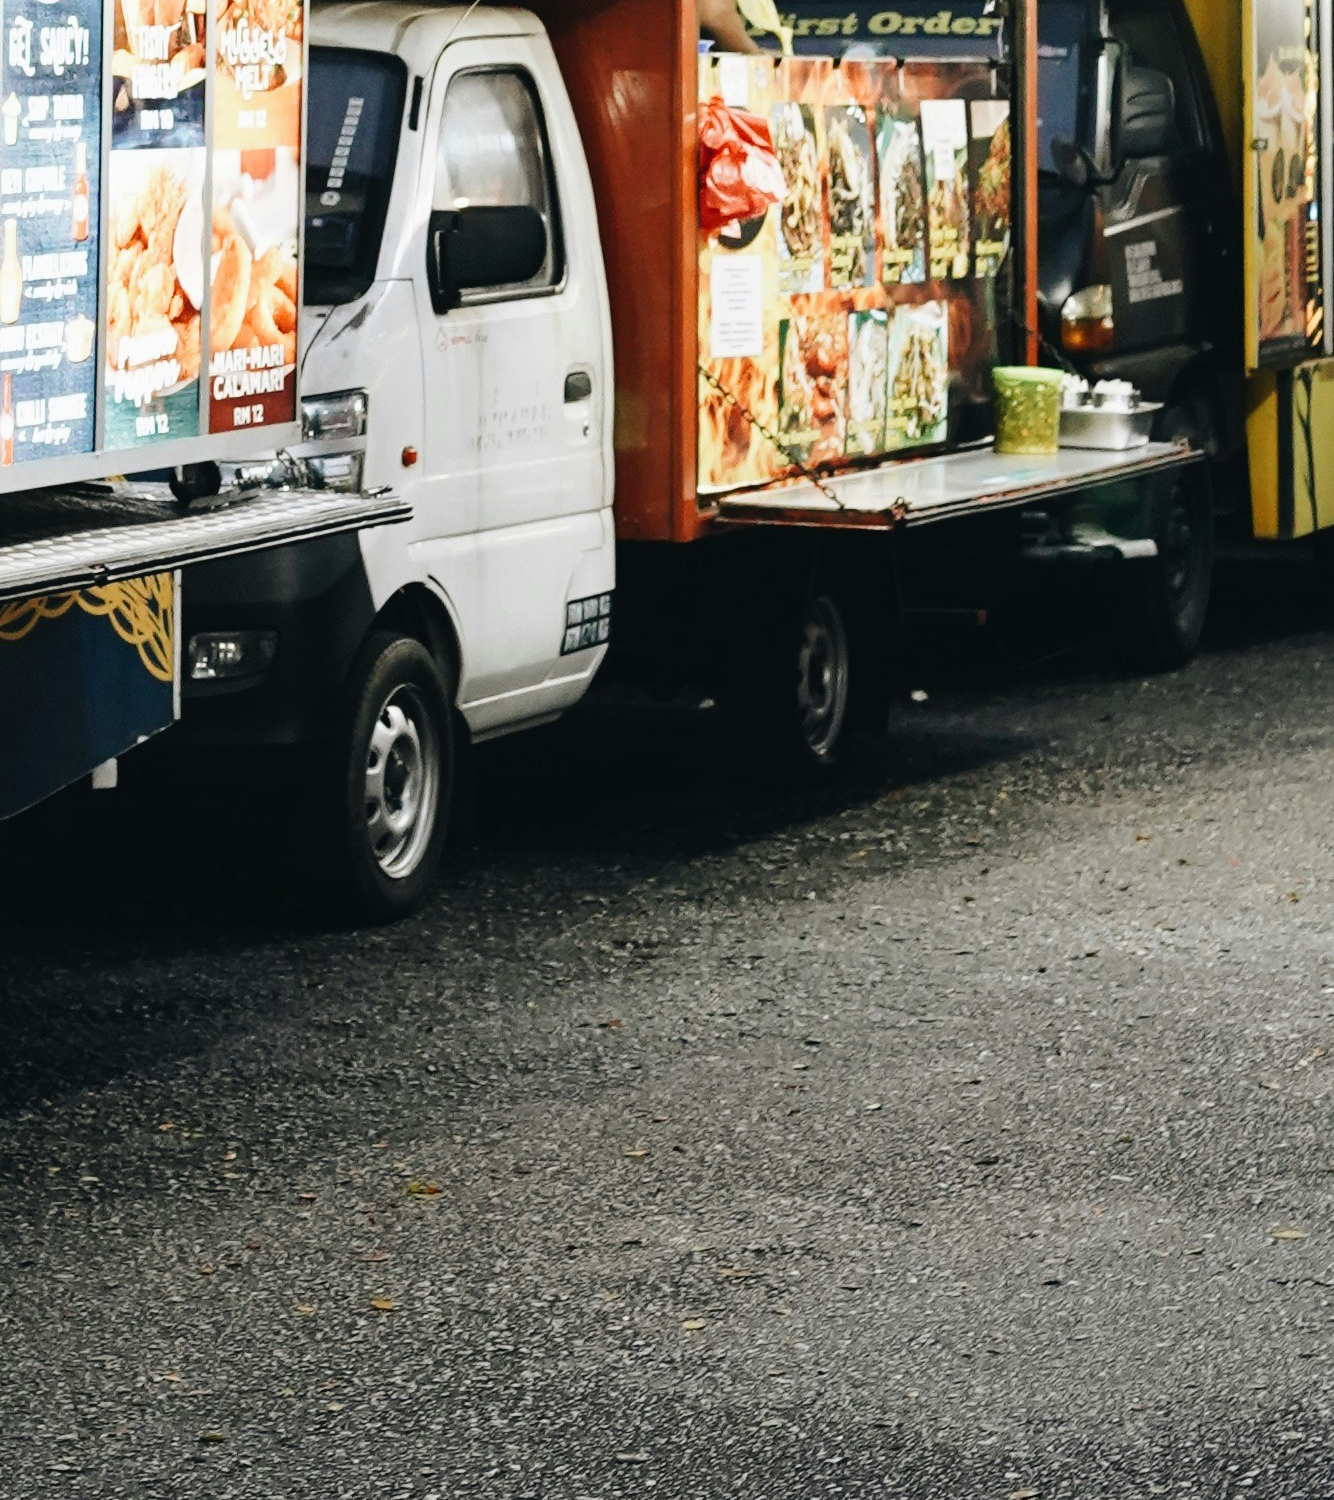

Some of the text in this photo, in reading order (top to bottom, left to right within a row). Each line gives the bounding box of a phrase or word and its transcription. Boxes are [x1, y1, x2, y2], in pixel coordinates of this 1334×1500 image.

[867, 10, 1002, 36] Order
[213, 344, 285, 374] MARI-MARI
[156, 413, 170, 434] 12
[233, 404, 265, 427] RM 12
